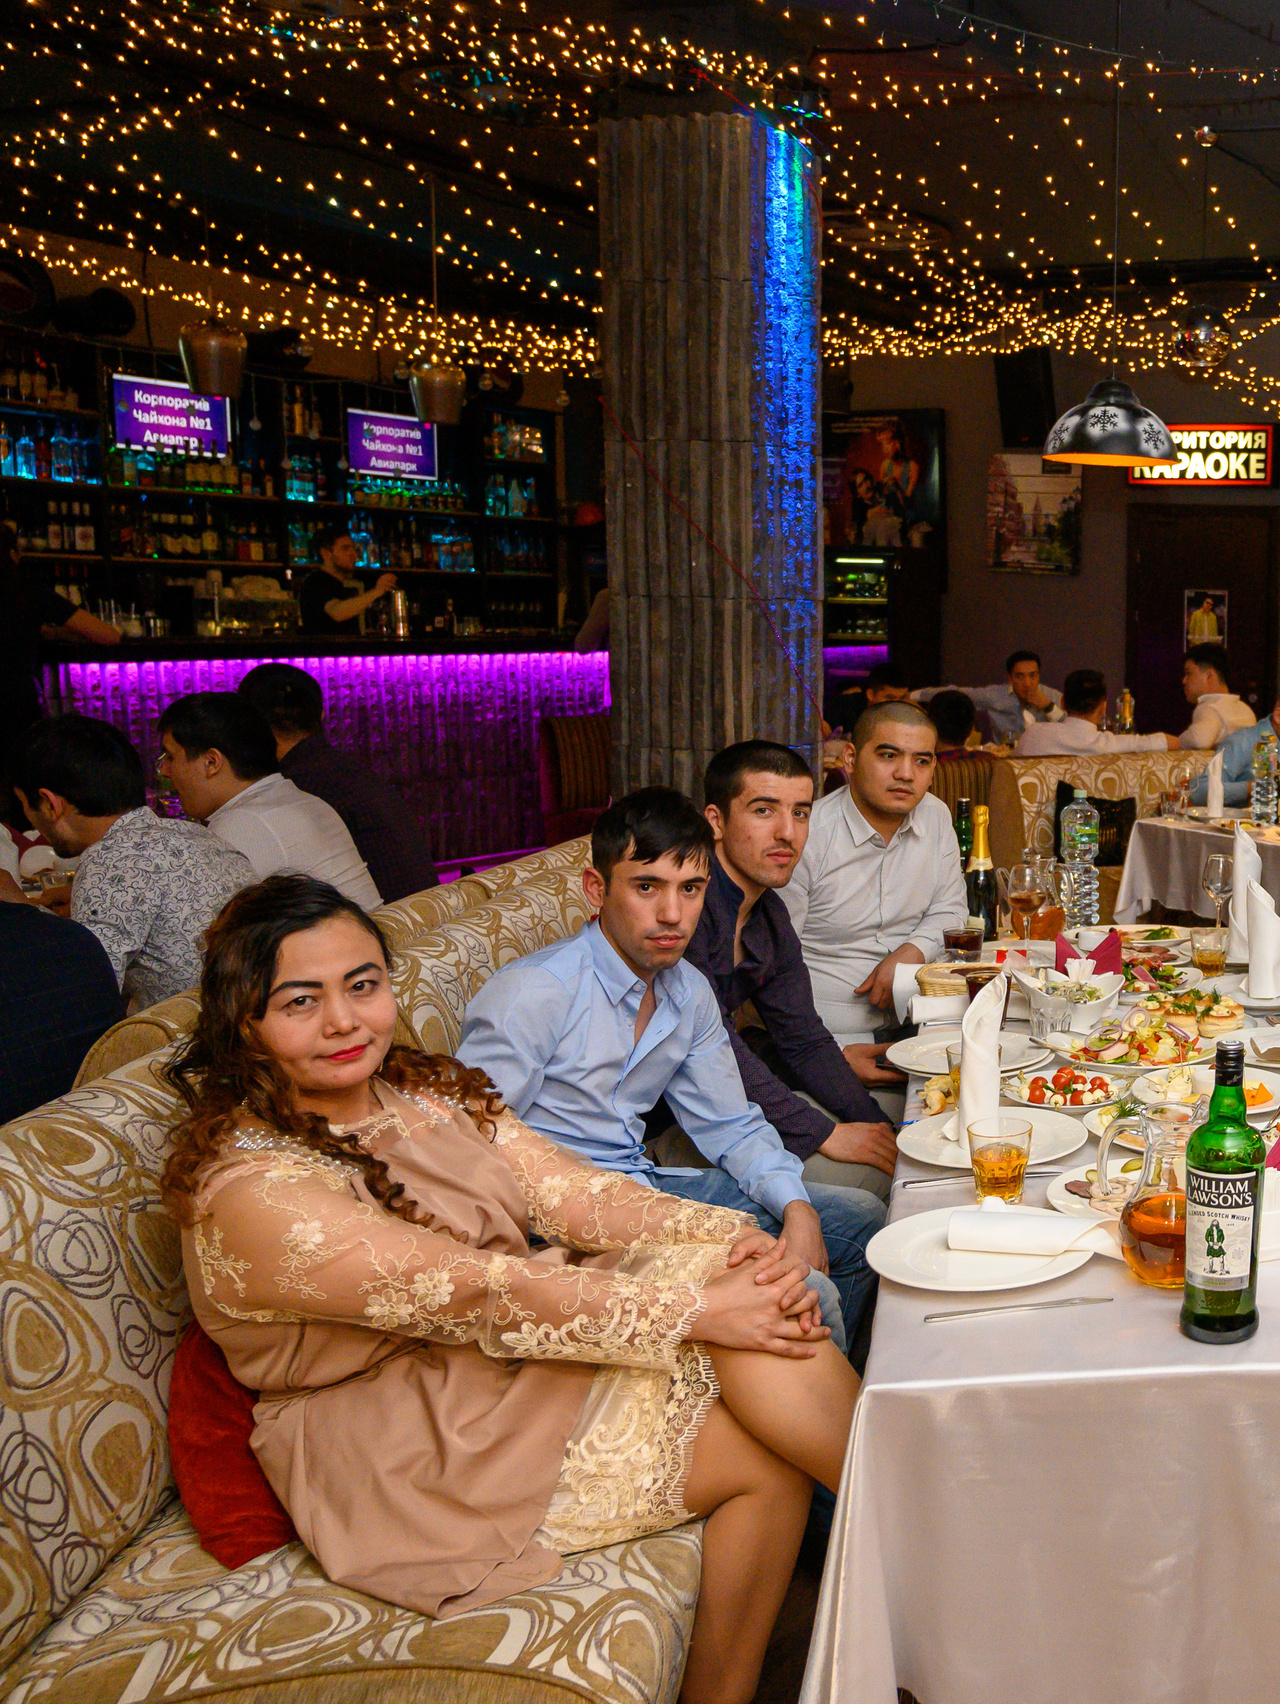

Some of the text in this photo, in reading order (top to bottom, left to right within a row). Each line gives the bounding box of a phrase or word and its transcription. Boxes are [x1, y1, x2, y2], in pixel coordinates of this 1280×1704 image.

[133, 408, 213, 430] Чайхона №1
[143, 429, 204, 449] Авиапр
[1171, 430, 1267, 450] РИТОРИЯ
[405, 443, 423, 456] №1
[370, 455, 417, 473] Авиапарк
[1189, 1174, 1249, 1193] WILLIAM
[1187, 1188, 1252, 1207] LAWSON'S
[1207, 1211, 1229, 1219] SCOTCH
